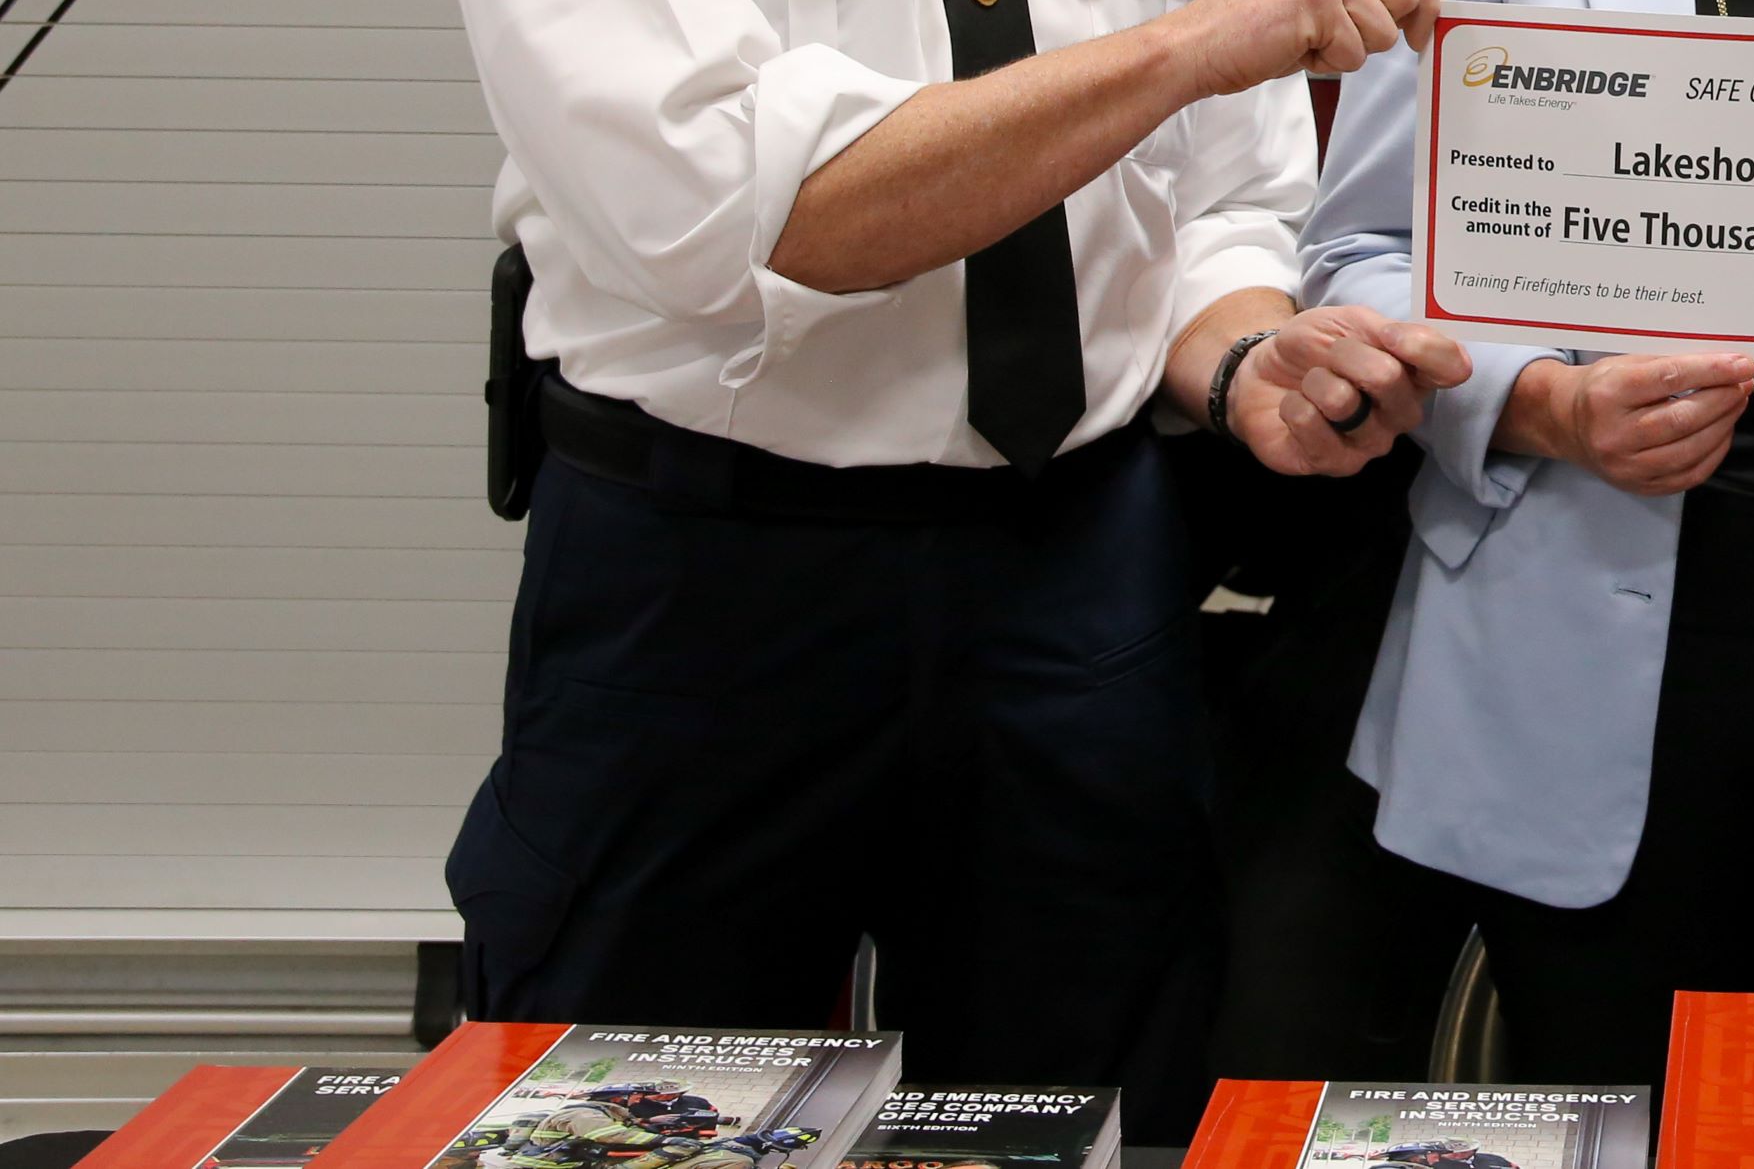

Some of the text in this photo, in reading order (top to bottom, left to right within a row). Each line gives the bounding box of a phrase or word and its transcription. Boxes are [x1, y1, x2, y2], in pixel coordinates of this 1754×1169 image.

[1490, 64, 1651, 98] ENBRIDGE
[1685, 77, 1745, 102] SAFE
[1488, 93, 1506, 106] Life
[1508, 95, 1536, 108] Takes
[1450, 149, 1556, 172] Presented to
[1450, 194, 1552, 217] Credit in the
[1465, 219, 1553, 238] amount of
[1563, 205, 1631, 244] Five
[1452, 270, 1706, 305] Training Firefighters to be their best.
[589, 1032, 883, 1049] FIRE AND EMERGENCY
[660, 1044, 796, 1056] SERVICES
[627, 1053, 812, 1067] INSTRUCTOR
[707, 1065, 763, 1073] EDITION
[317, 1075, 381, 1085] FIRE
[314, 1085, 393, 1095] SERV
[1349, 1090, 1637, 1104] FIRE AND EMERGENCY
[887, 1092, 1095, 1104] ND EMERGENCY
[943, 1102, 1082, 1114] COMPANY
[1425, 1101, 1557, 1111] SERVICES
[878, 1111, 992, 1122] OFFICER
[1399, 1110, 1580, 1122] INSTRUCTOR
